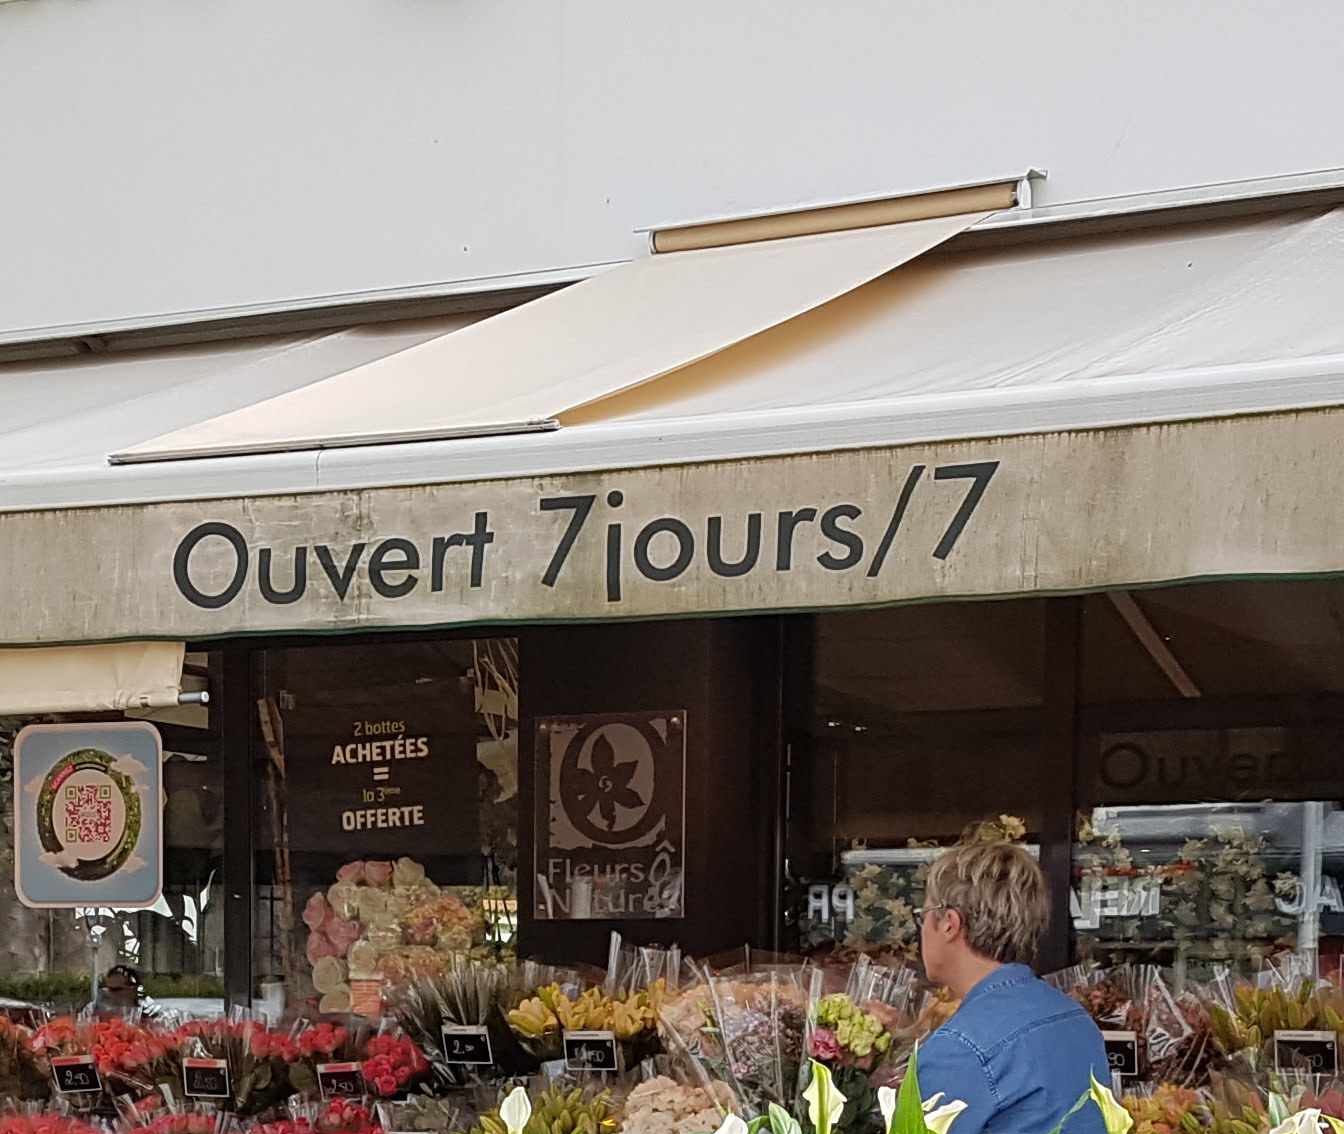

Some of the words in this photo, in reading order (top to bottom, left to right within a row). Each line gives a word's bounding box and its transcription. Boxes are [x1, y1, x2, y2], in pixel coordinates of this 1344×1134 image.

[173, 511, 494, 609] Ouvert
[539, 461, 1001, 602] 7jours/7
[354, 722, 363, 737] 2
[365, 720, 406, 736] bottes
[331, 734, 429, 765] ACHETÉES
[363, 788, 375, 803] la
[342, 805, 425, 831] OFFERTE
[548, 858, 646, 884] Fleurs
